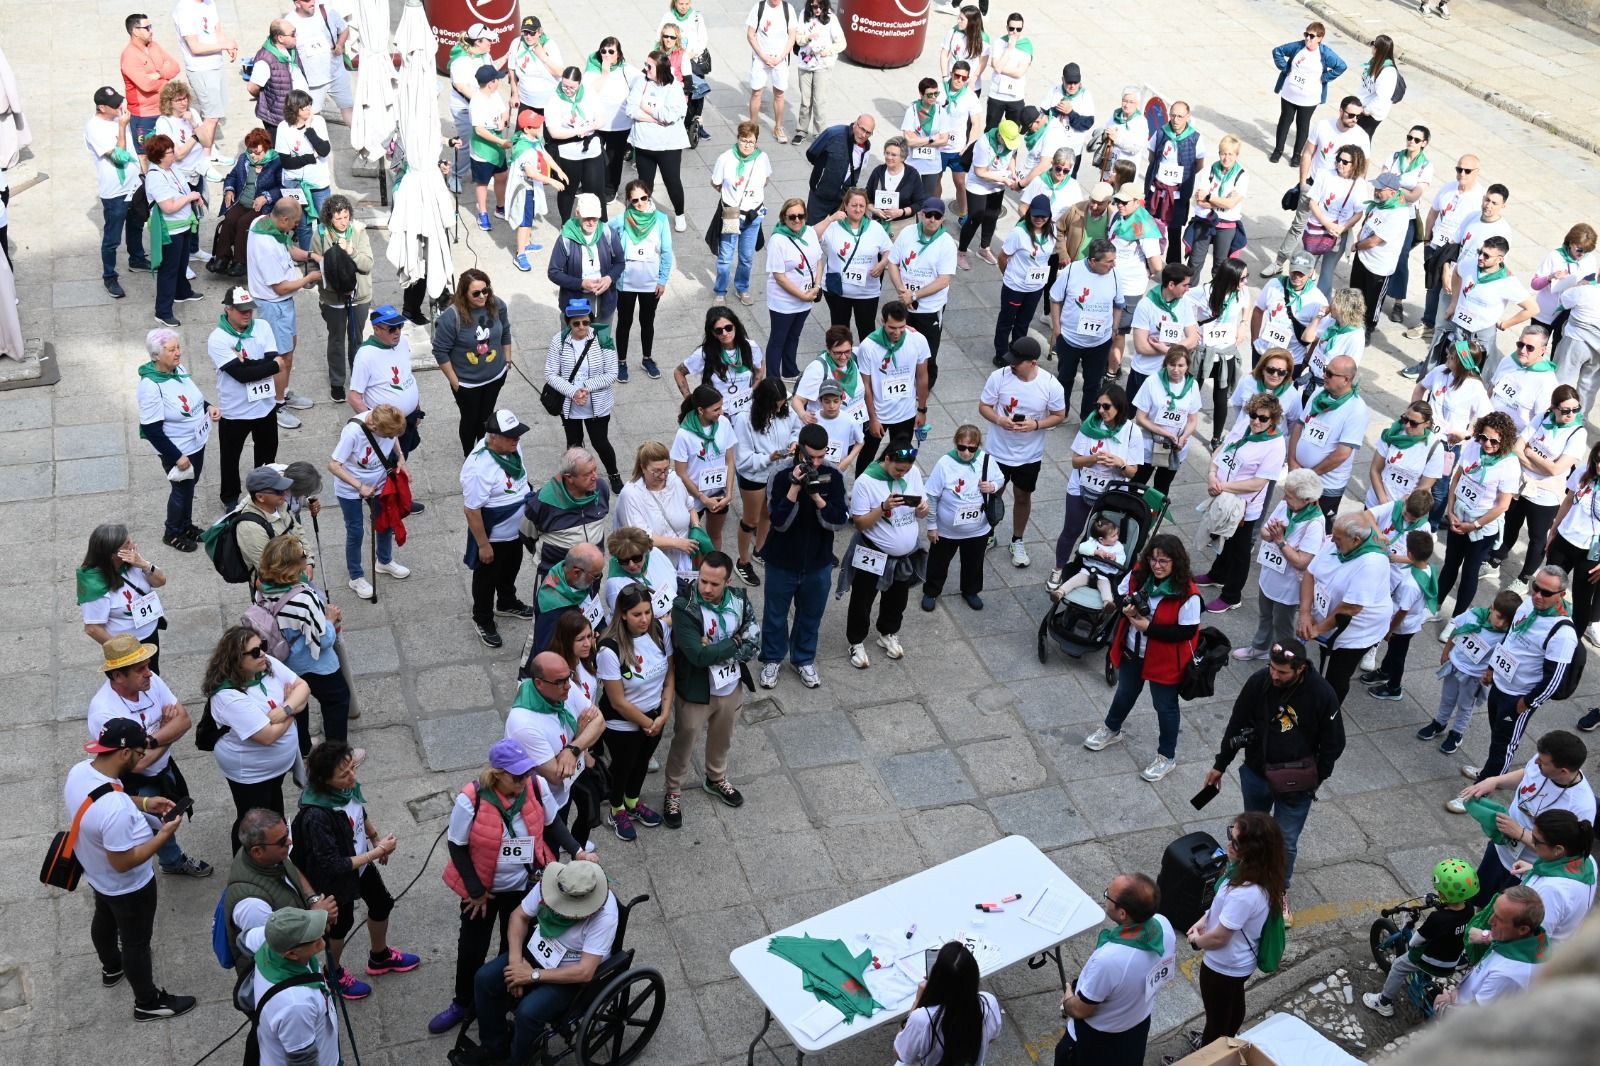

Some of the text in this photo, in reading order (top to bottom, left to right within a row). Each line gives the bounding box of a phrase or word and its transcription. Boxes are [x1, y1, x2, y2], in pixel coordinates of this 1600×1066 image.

[1164, 170, 1178, 178] 215
[845, 272, 862, 281] 179
[1030, 272, 1045, 280] 181
[905, 283, 920, 291] 161
[1458, 312, 1472, 325] 222
[1083, 322, 1101, 331] 117
[1164, 330, 1178, 338] 199
[1270, 330, 1285, 342] 198
[252, 384, 270, 394] 119
[888, 384, 906, 394] 112
[1502, 384, 1516, 398] 182
[1163, 411, 1181, 421] 208
[1309, 428, 1325, 440] 178
[704, 474, 722, 484] 115
[1086, 475, 1105, 487] 114
[1390, 473, 1409, 486] 151
[1461, 486, 1477, 501] 192
[960, 511, 979, 520] 150
[862, 556, 876, 566] 21
[1264, 552, 1282, 566] 120
[657, 594, 670, 608] 31
[1316, 593, 1326, 609] 113
[140, 605, 153, 617] 91
[1462, 636, 1480, 655] 191
[1495, 655, 1511, 673] 183
[718, 663, 736, 679] 174
[502, 846, 522, 857] 86
[537, 940, 553, 958] 85
